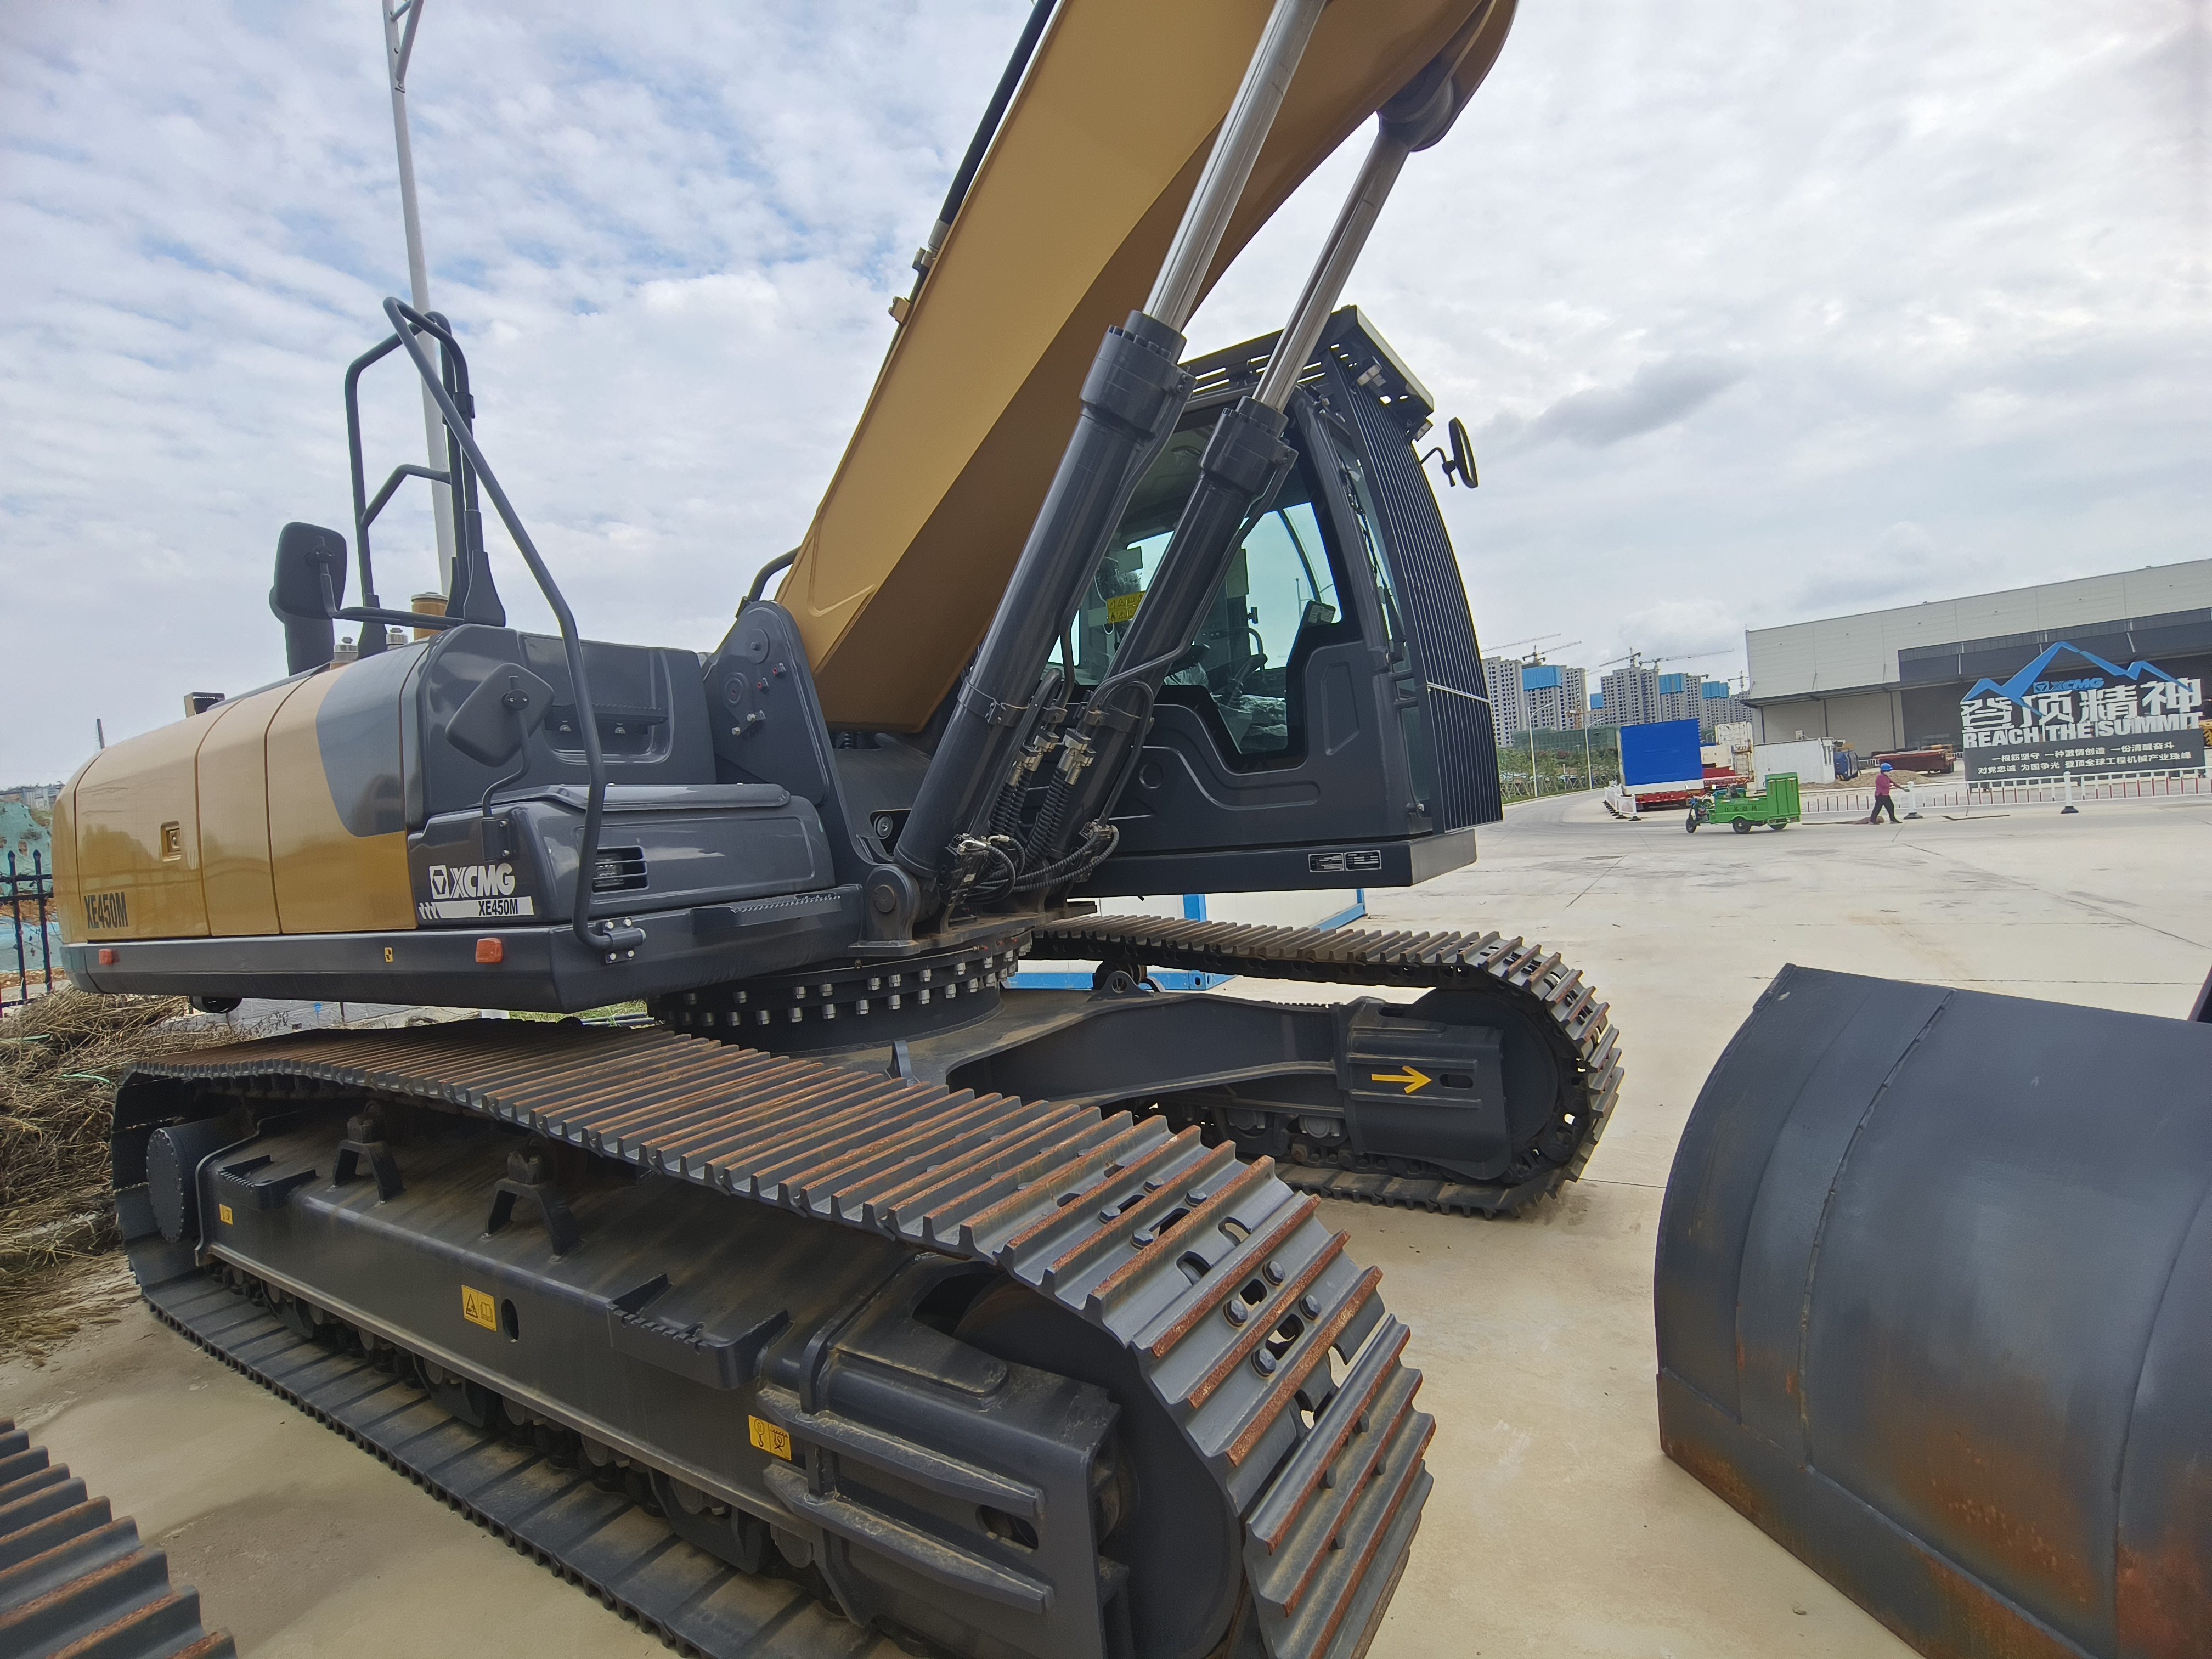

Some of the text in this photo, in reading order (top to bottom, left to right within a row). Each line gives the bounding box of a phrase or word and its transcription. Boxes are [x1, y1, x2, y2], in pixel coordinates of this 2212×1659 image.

[2050, 677, 2104, 691] XCMG
[1960, 677, 2202, 733] 登顶精神
[1962, 712, 2203, 749] REACH THE SUMMIT
[450, 862, 515, 898] XCMG
[83, 891, 129, 929] XE450M
[478, 898, 518, 916] XE450M
